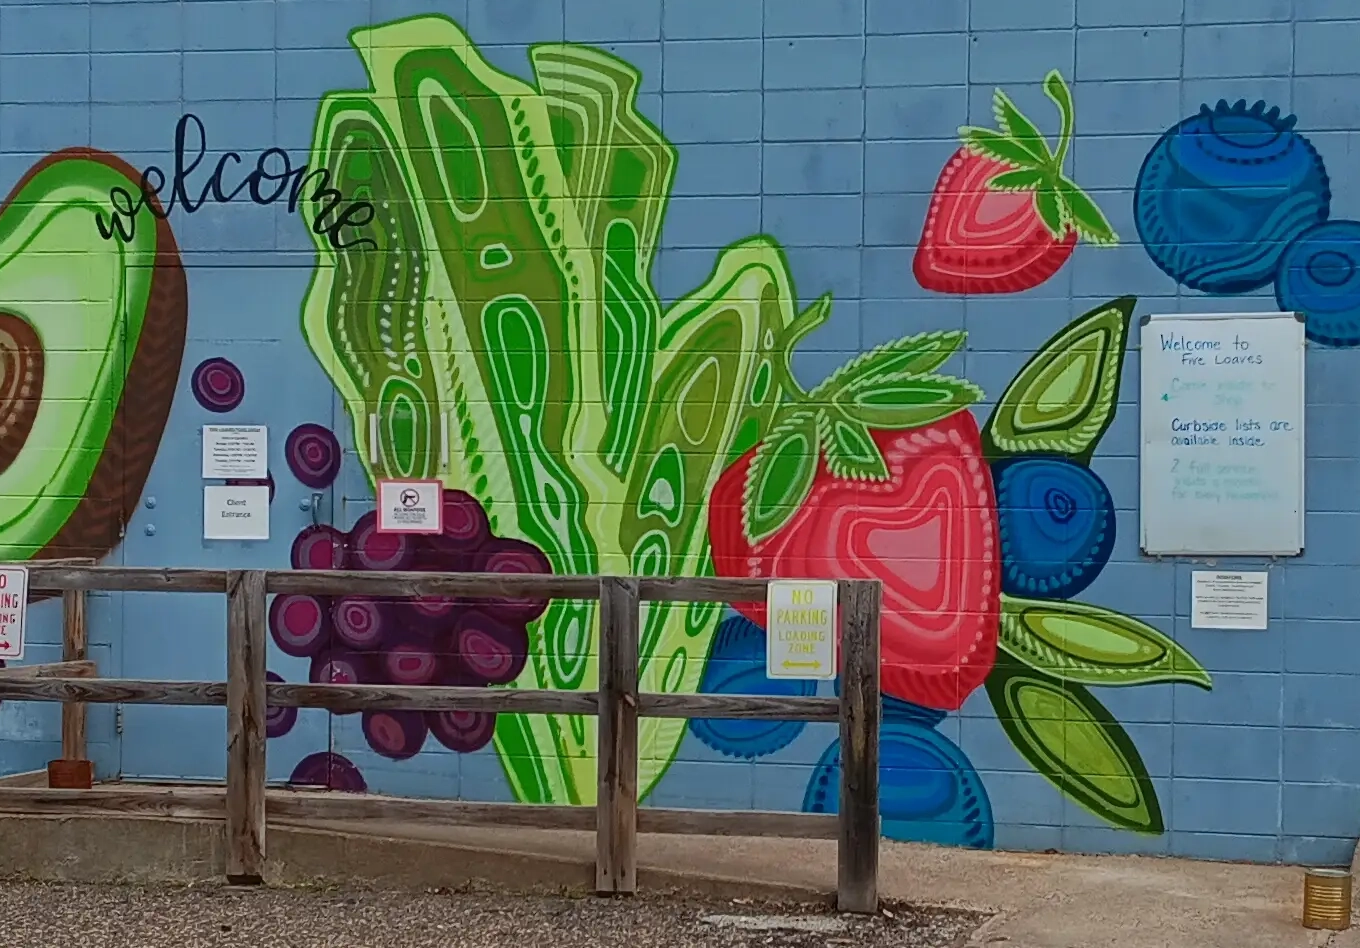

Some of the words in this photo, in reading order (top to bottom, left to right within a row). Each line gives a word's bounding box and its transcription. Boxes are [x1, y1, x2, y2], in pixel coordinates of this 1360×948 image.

[95, 113, 378, 251] welcome
[1160, 332, 1221, 351] Welcome
[1232, 334, 1250, 350] to
[1181, 354, 1207, 366] Five
[1214, 354, 1263, 366] Loaves
[1171, 418, 1227, 432] Curbside
[1235, 418, 1261, 432] lists
[1269, 420, 1295, 432] are
[1171, 435, 1219, 447] available
[1228, 435, 1266, 447] inside
[226, 498, 247, 506] Client
[221, 510, 252, 518] Entrance
[791, 590, 813, 605] NO
[776, 609, 828, 625] PARKING
[778, 630, 825, 642] LOADING
[788, 643, 816, 654] ZONE
